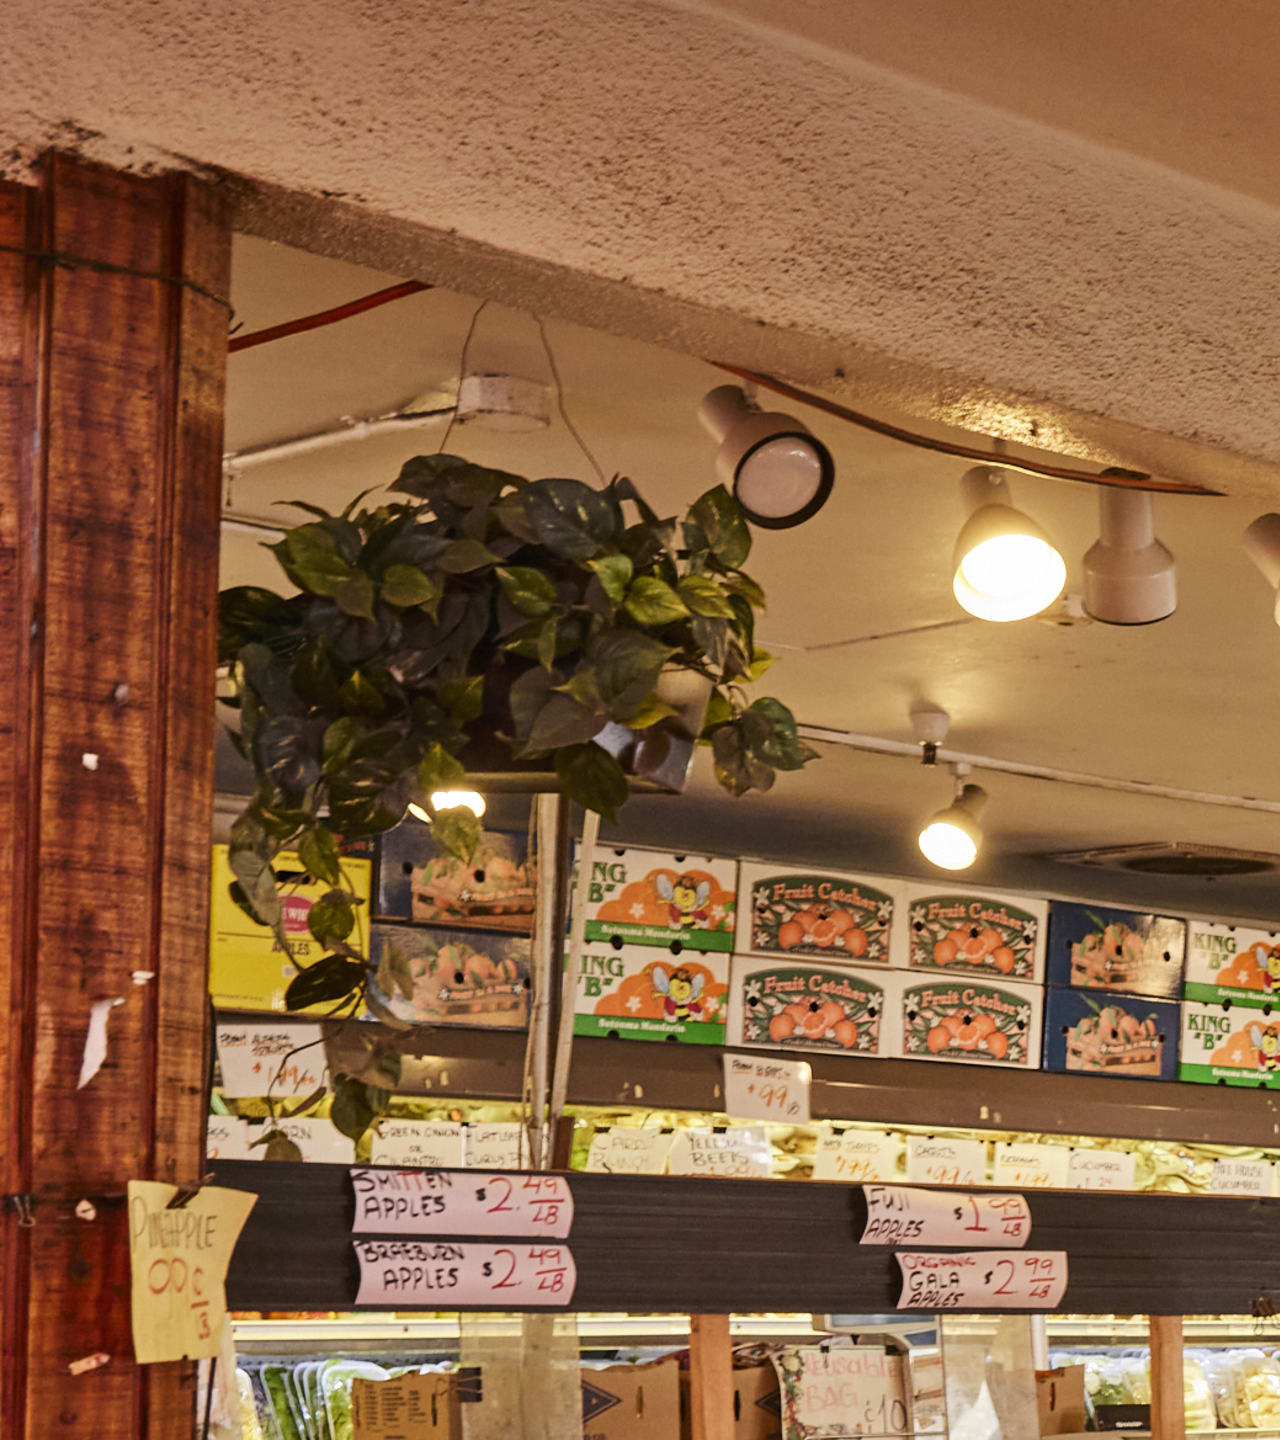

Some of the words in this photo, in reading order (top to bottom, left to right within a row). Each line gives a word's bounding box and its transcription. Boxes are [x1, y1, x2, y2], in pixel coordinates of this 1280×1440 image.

[773, 883, 814, 901] Fruit
[818, 883, 877, 912] Catcher
[928, 903, 966, 919] Fruit
[969, 903, 1024, 930] Catcher
[1193, 934, 1237, 953] KING
[581, 955, 625, 977] ING
[764, 976, 805, 994] Fruit
[808, 975, 868, 1002] Catcher
[922, 990, 960, 1007] Fruit
[962, 989, 1017, 1016] Catcher
[1187, 1014, 1232, 1034] KING
[1194, 1033, 1223, 1050] "B"
[352, 1170, 453, 1193] SMITTEN
[364, 1195, 446, 1220] APPLES
[864, 1218, 925, 1239] APPLES
[356, 1242, 465, 1263] BRAEBURN
[383, 1267, 460, 1291] APPLES
[909, 1270, 960, 1292] GALA
[907, 1291, 965, 1307] APPLES
[806, 1384, 858, 1412] BAG
